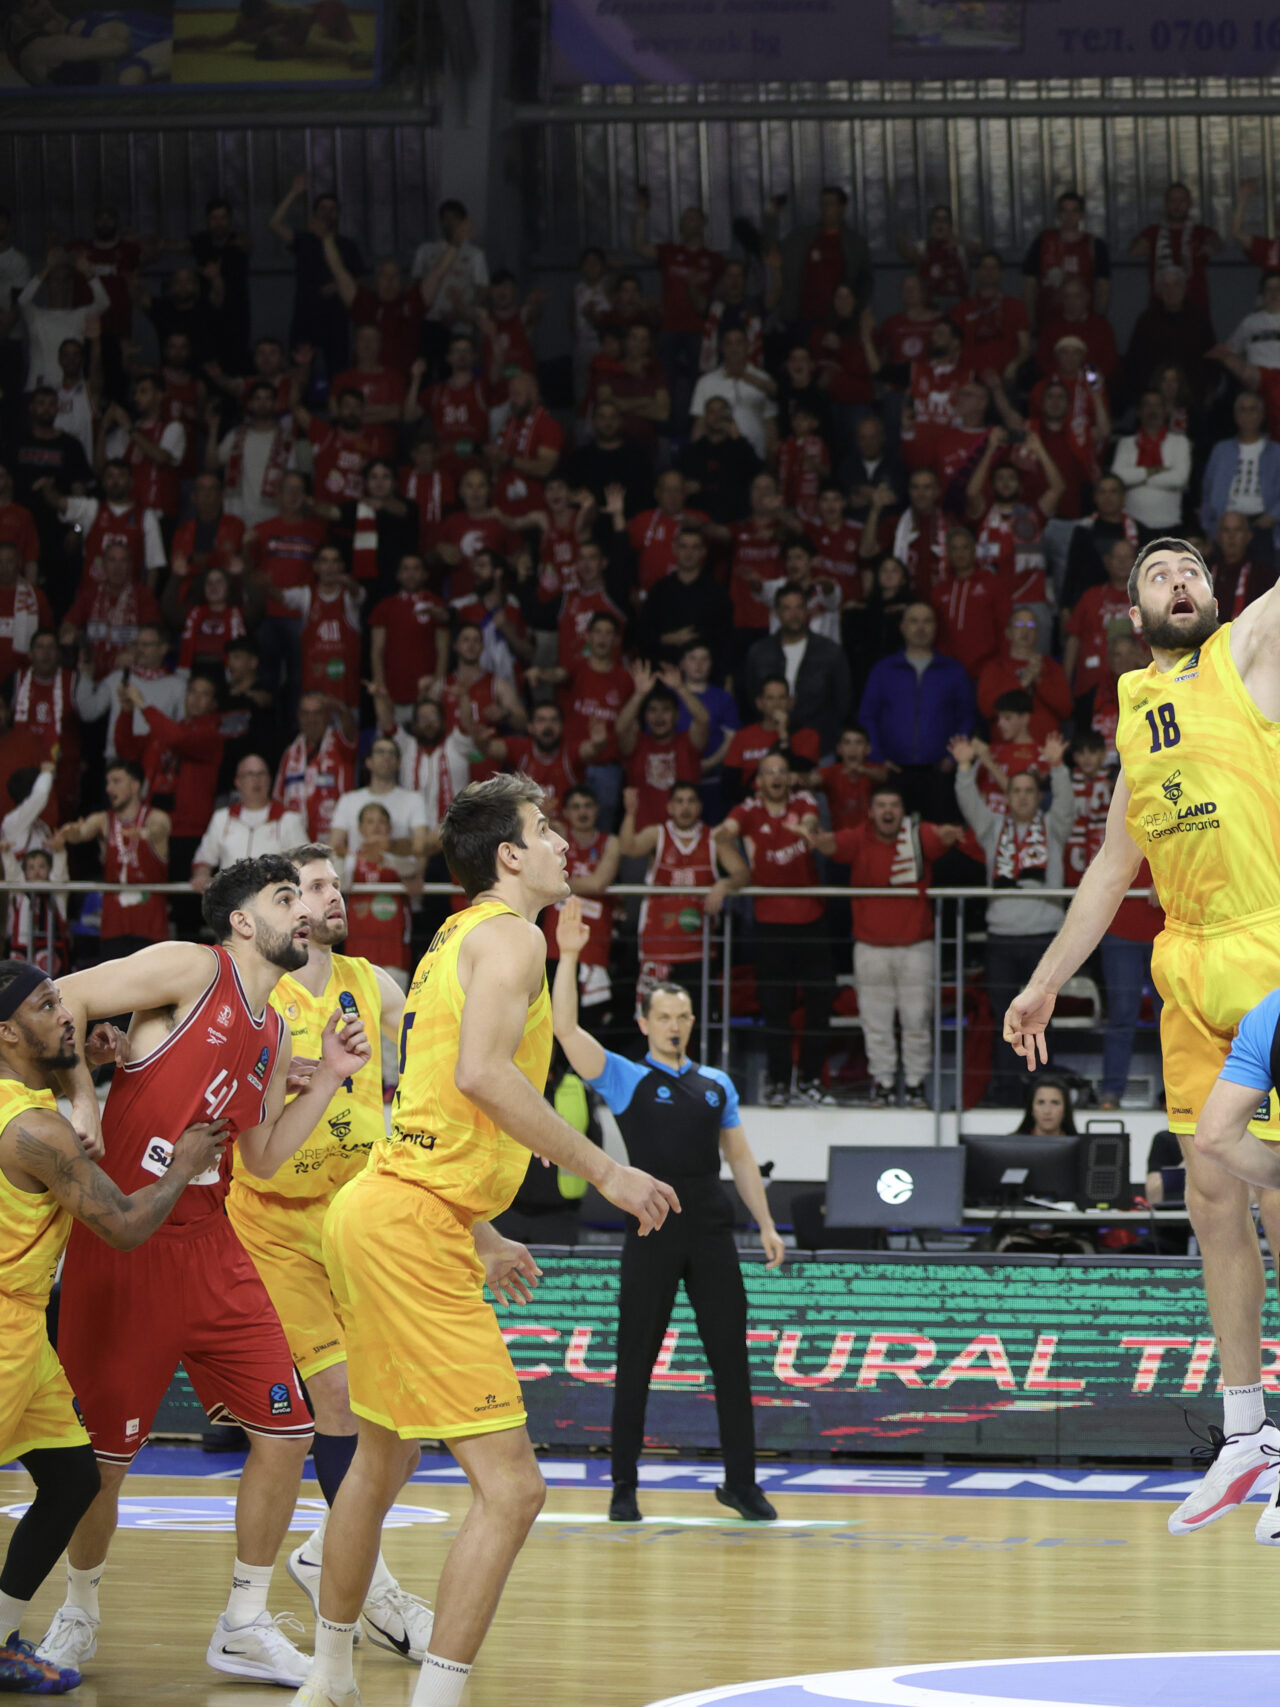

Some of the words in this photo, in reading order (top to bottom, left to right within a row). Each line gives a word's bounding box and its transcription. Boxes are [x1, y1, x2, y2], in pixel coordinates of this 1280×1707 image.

[1151, 21, 1238, 51] 0700
[1145, 702, 1182, 753] 18
[1152, 819, 1220, 839] GranCanaria
[204, 1069, 238, 1120] 41
